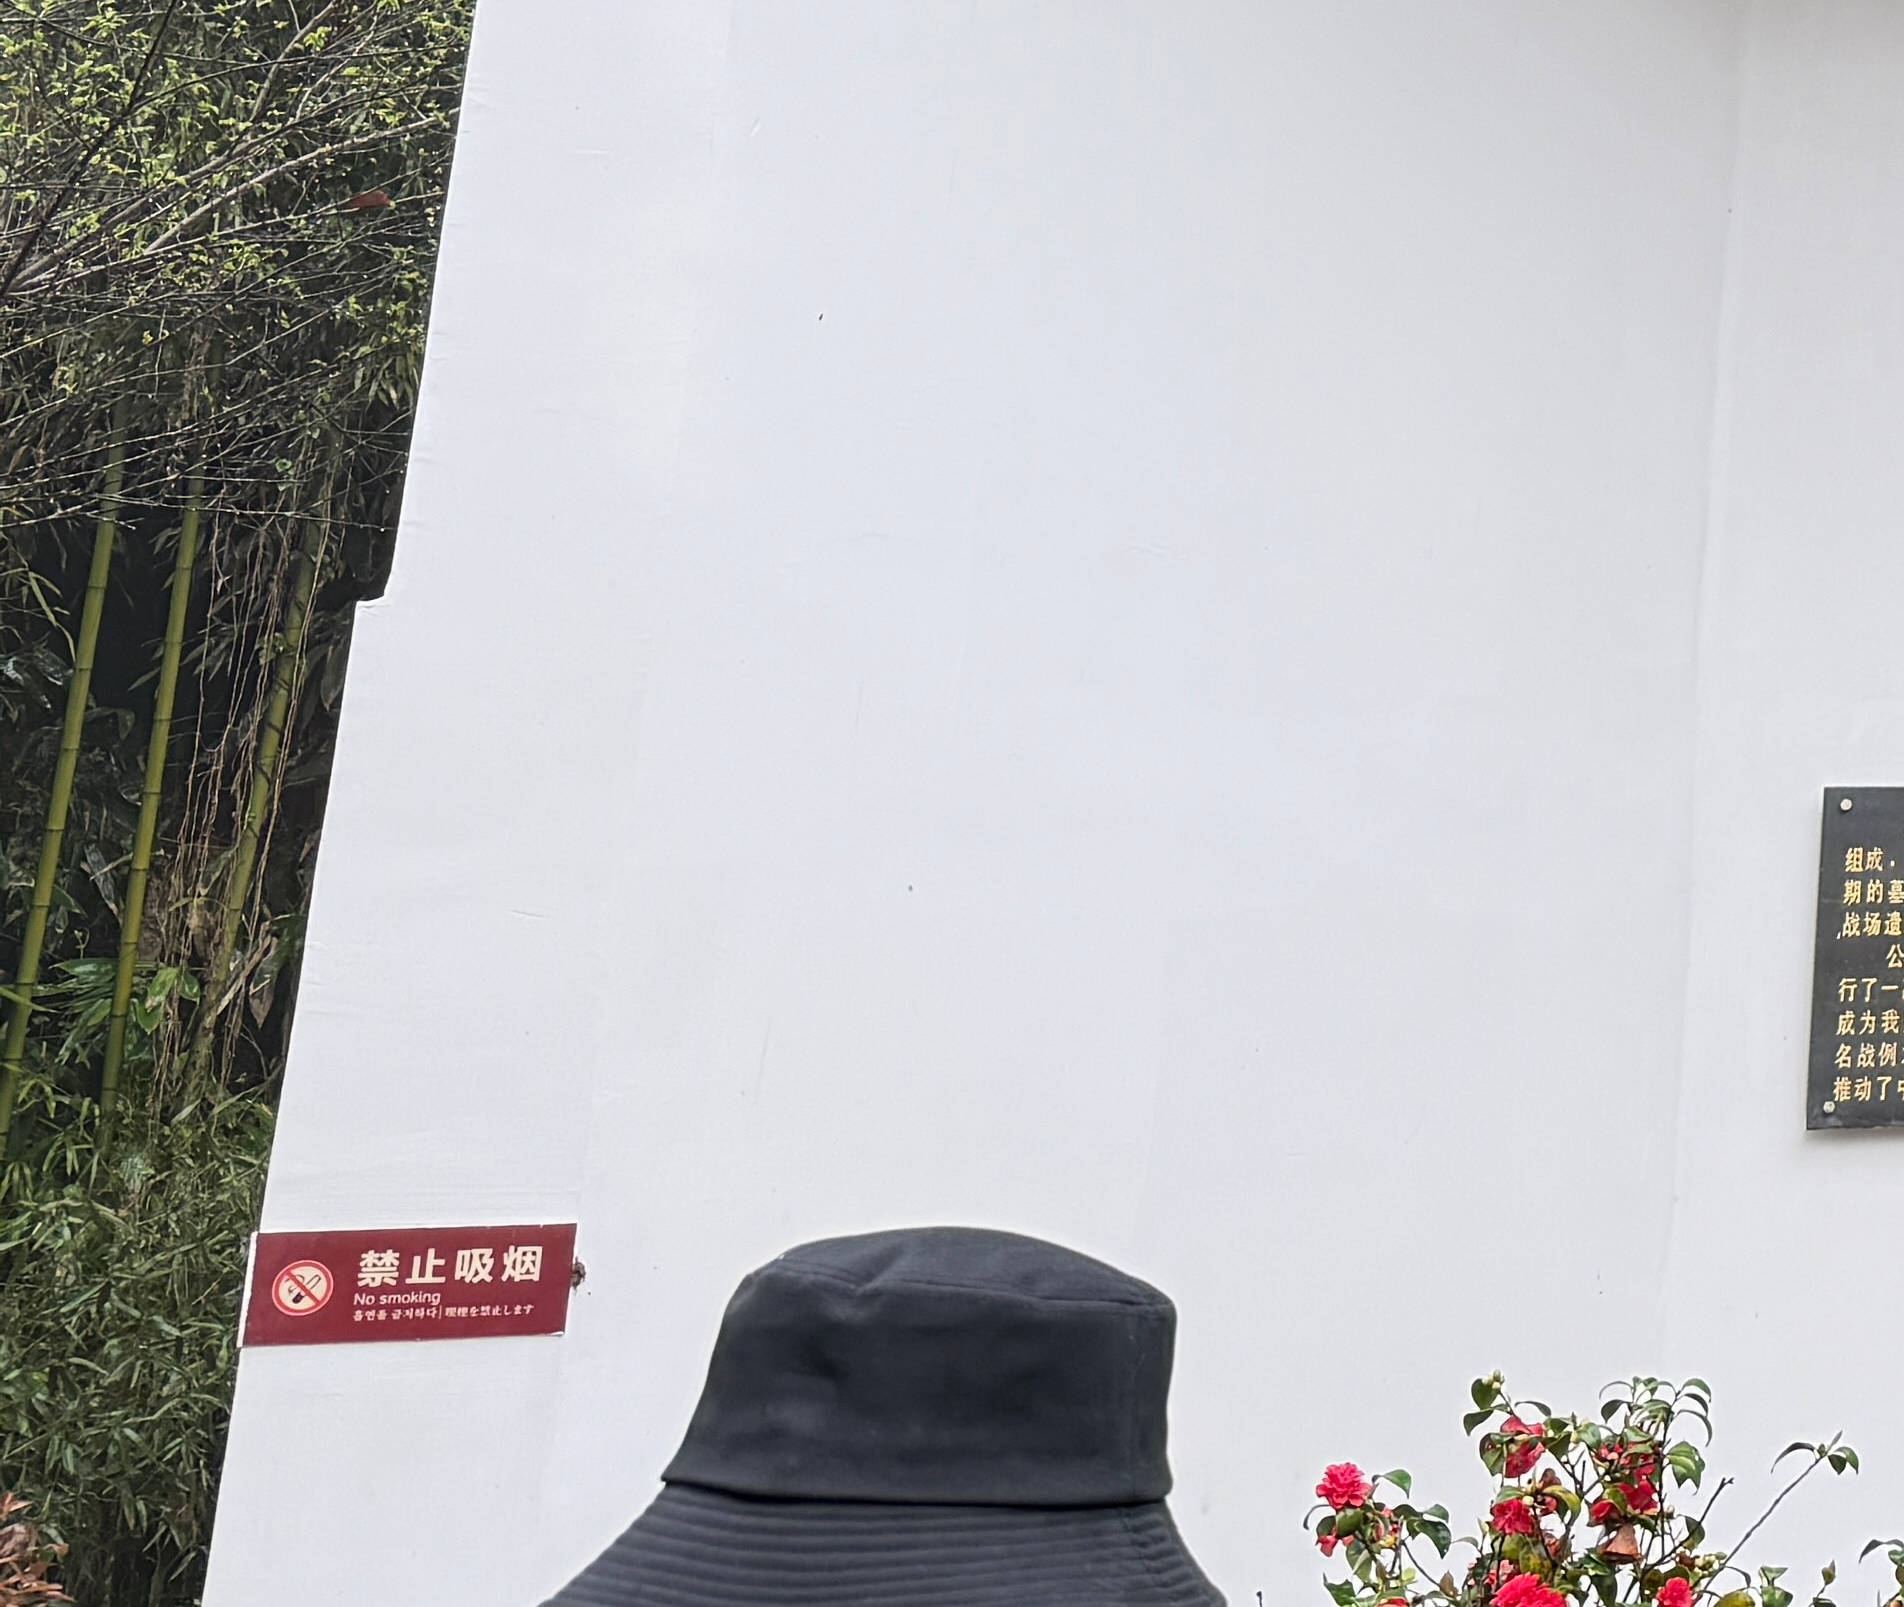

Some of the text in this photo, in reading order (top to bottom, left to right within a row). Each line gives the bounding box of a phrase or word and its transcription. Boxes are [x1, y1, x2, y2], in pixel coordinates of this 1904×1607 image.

[357, 1246, 543, 1288] 禁止吸烟
[354, 1291, 441, 1306] No smoking
